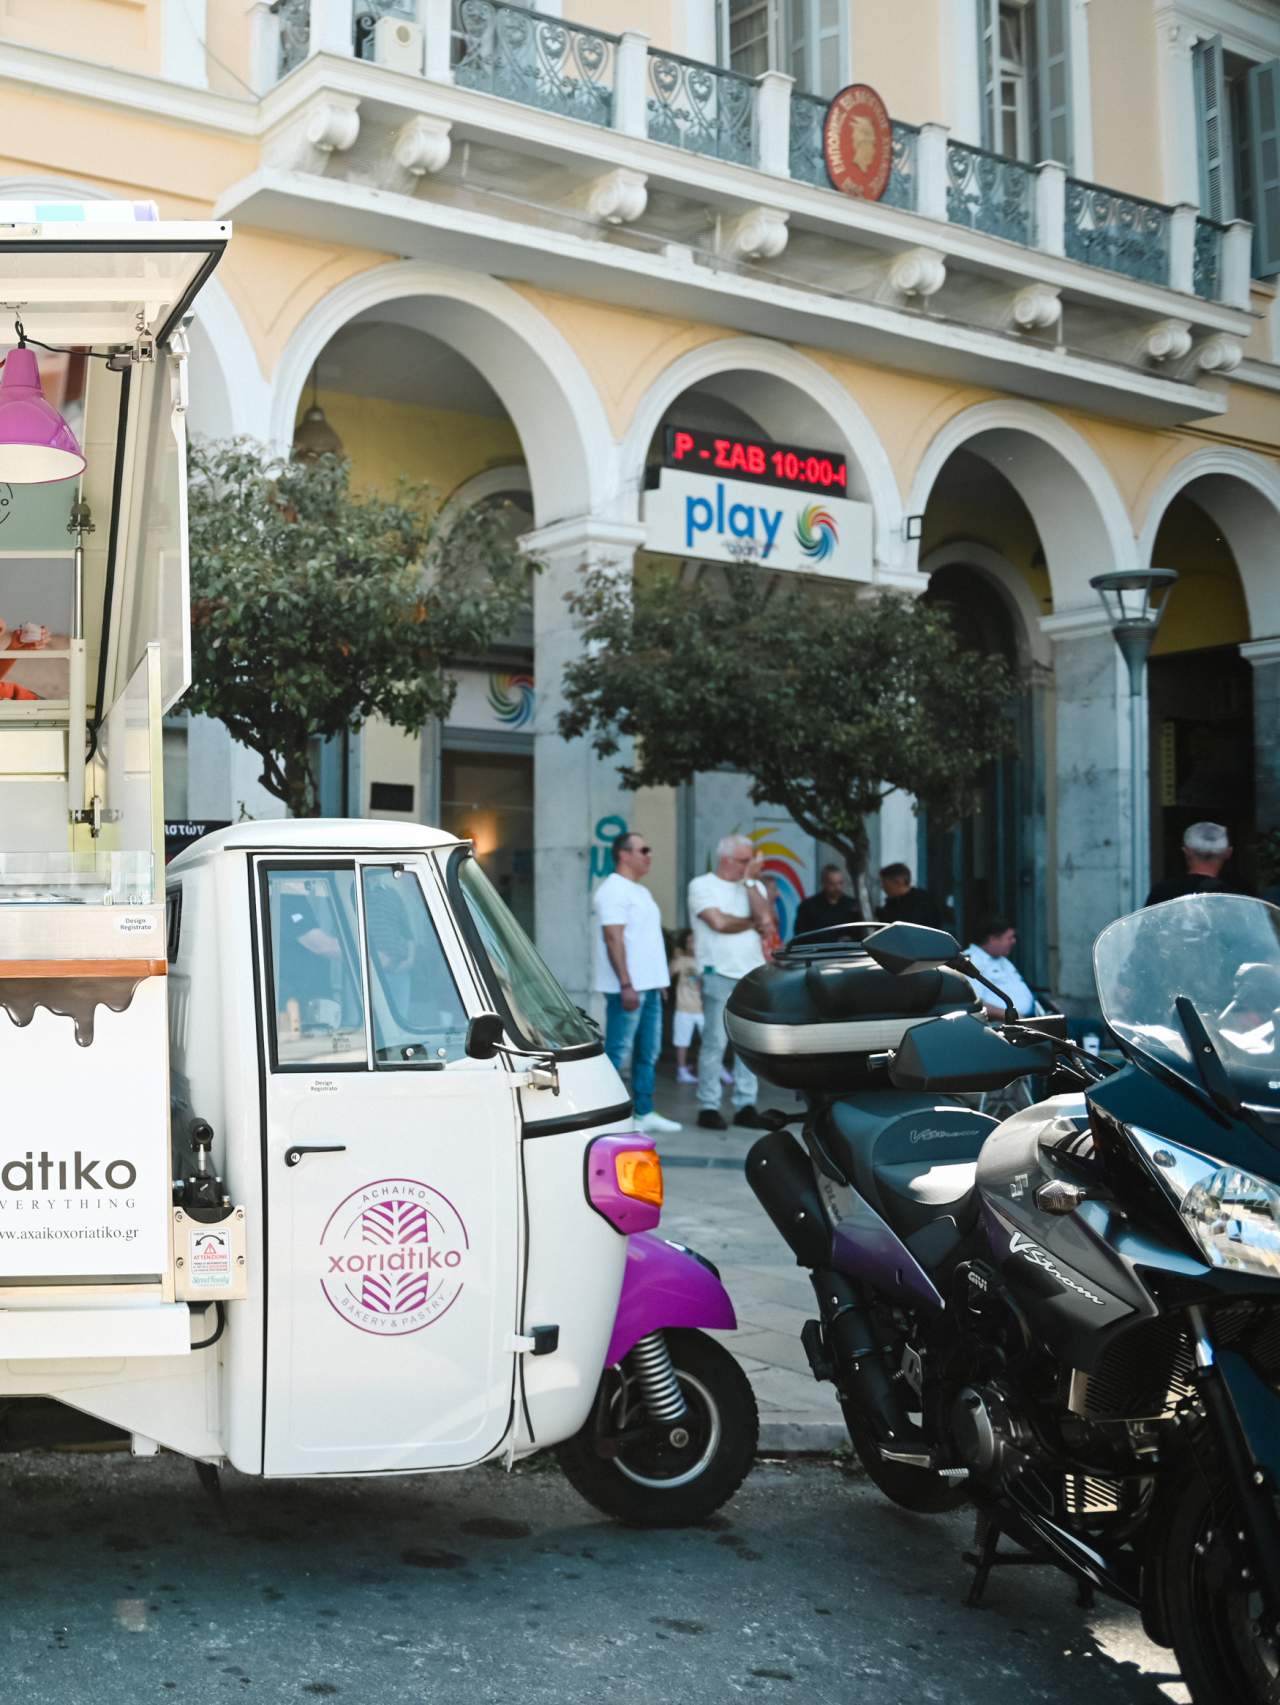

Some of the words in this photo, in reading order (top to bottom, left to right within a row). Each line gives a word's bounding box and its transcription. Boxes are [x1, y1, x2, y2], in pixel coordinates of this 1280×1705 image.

[713, 439, 767, 475] ΣΑΒ
[685, 482, 783, 558] play
[362, 1184, 427, 1204] ACHAIKO
[967, 1271, 988, 1293] GIVI
[340, 1296, 387, 1328] BAKERY
[389, 1318, 399, 1328] &
[401, 1293, 446, 1328] PASTRY
